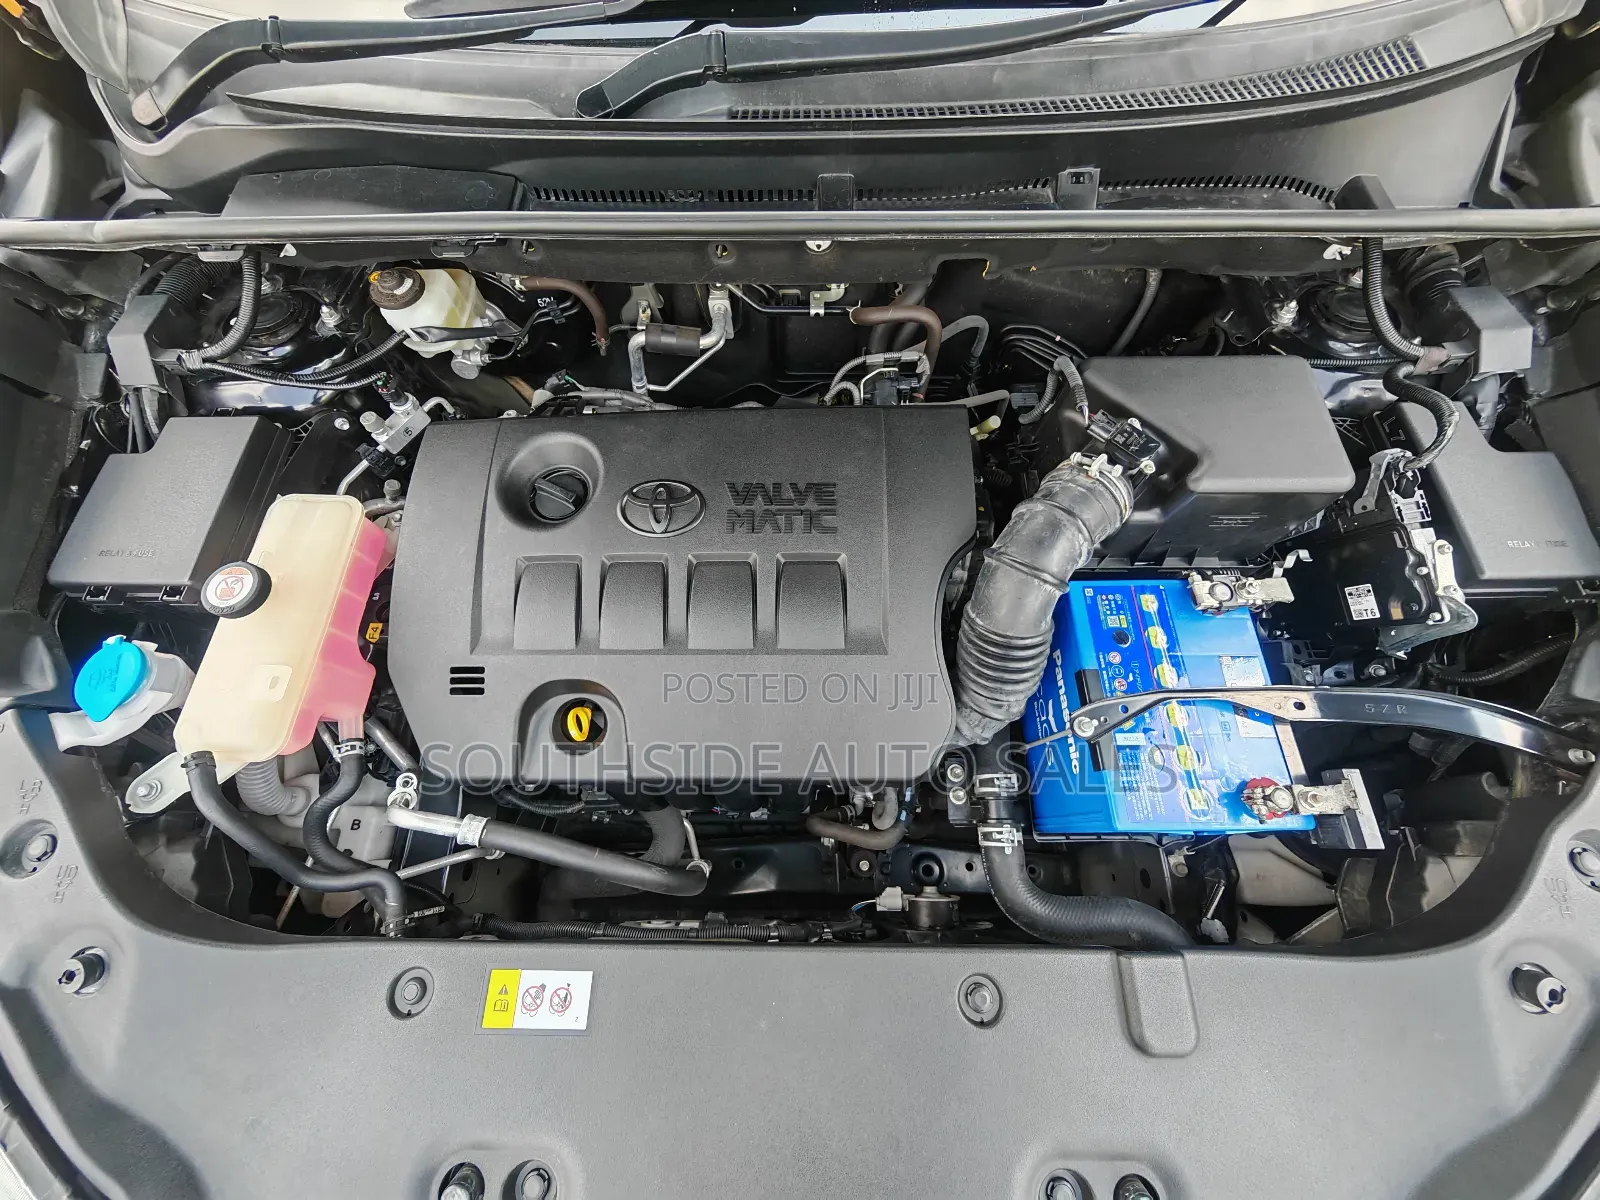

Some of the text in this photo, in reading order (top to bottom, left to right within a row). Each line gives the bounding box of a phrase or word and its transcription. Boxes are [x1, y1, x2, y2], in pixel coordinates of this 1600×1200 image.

[724, 482, 837, 507] VALVE
[725, 508, 838, 535] MATIC
[1506, 540, 1535, 548] RELAY
[350, 818, 361, 830] B
